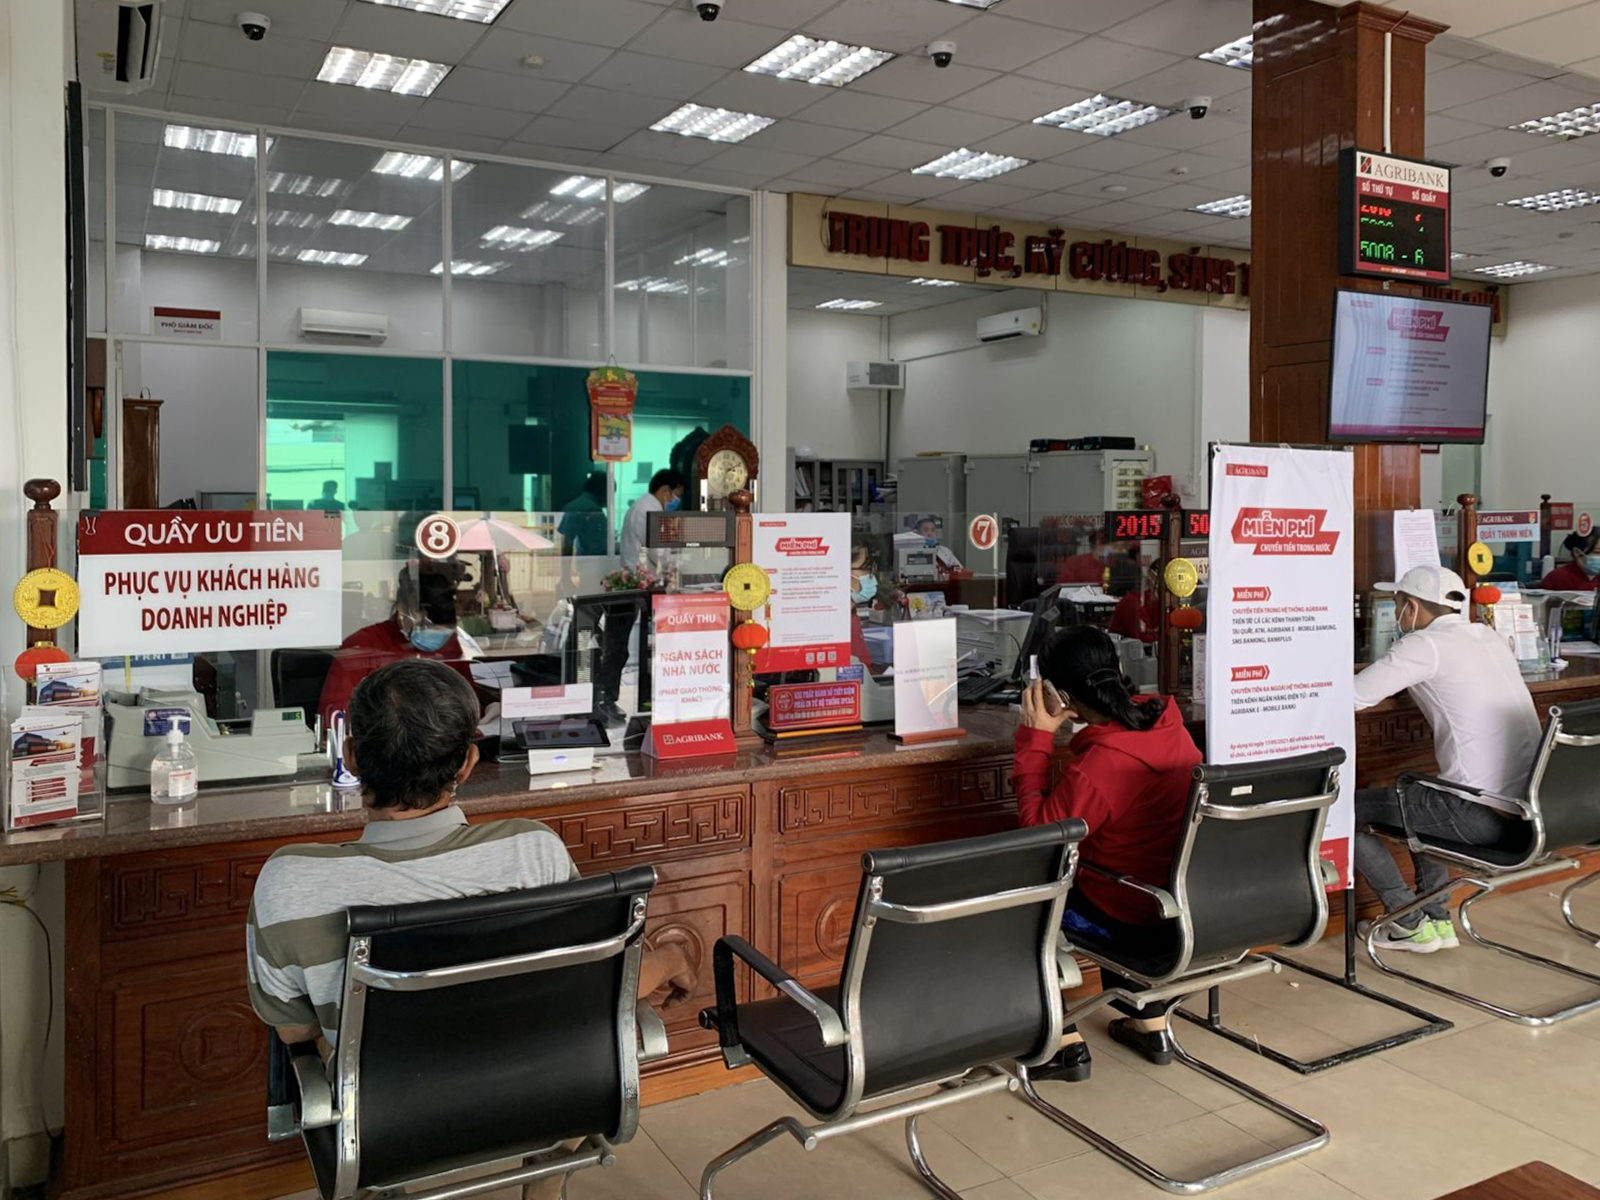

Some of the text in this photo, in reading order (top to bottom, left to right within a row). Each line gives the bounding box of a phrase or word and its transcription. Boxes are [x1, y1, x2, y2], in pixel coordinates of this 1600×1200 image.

[1374, 162, 1446, 188] AGRIBANK
[827, 211, 930, 262] TRUNG
[937, 224, 1022, 278] THỰC,
[1025, 228, 1066, 275] KỶ
[1070, 239, 1168, 293] CƯƠNG,
[1168, 246, 1236, 295] SÁNG
[1116, 513, 1162, 536] 2015
[1242, 511, 1315, 537] MIỄN PHÍ
[1482, 515, 1514, 523] AGRIBANK
[124, 515, 304, 547] QUẦY ƯU TIÊN
[427, 521, 450, 550] 8
[976, 521, 991, 544] 7
[1498, 530, 1518, 539] THANH
[104, 562, 321, 601] PHỤC VỤ KHÁCH HÀNG
[141, 599, 288, 632] DOANH NGHIỆP
[696, 613, 716, 624] THU
[660, 648, 723, 662] NGÂN SÁCH
[662, 663, 721, 677] NHÀ NƯỚC
[674, 732, 724, 744] AGRIBANK
